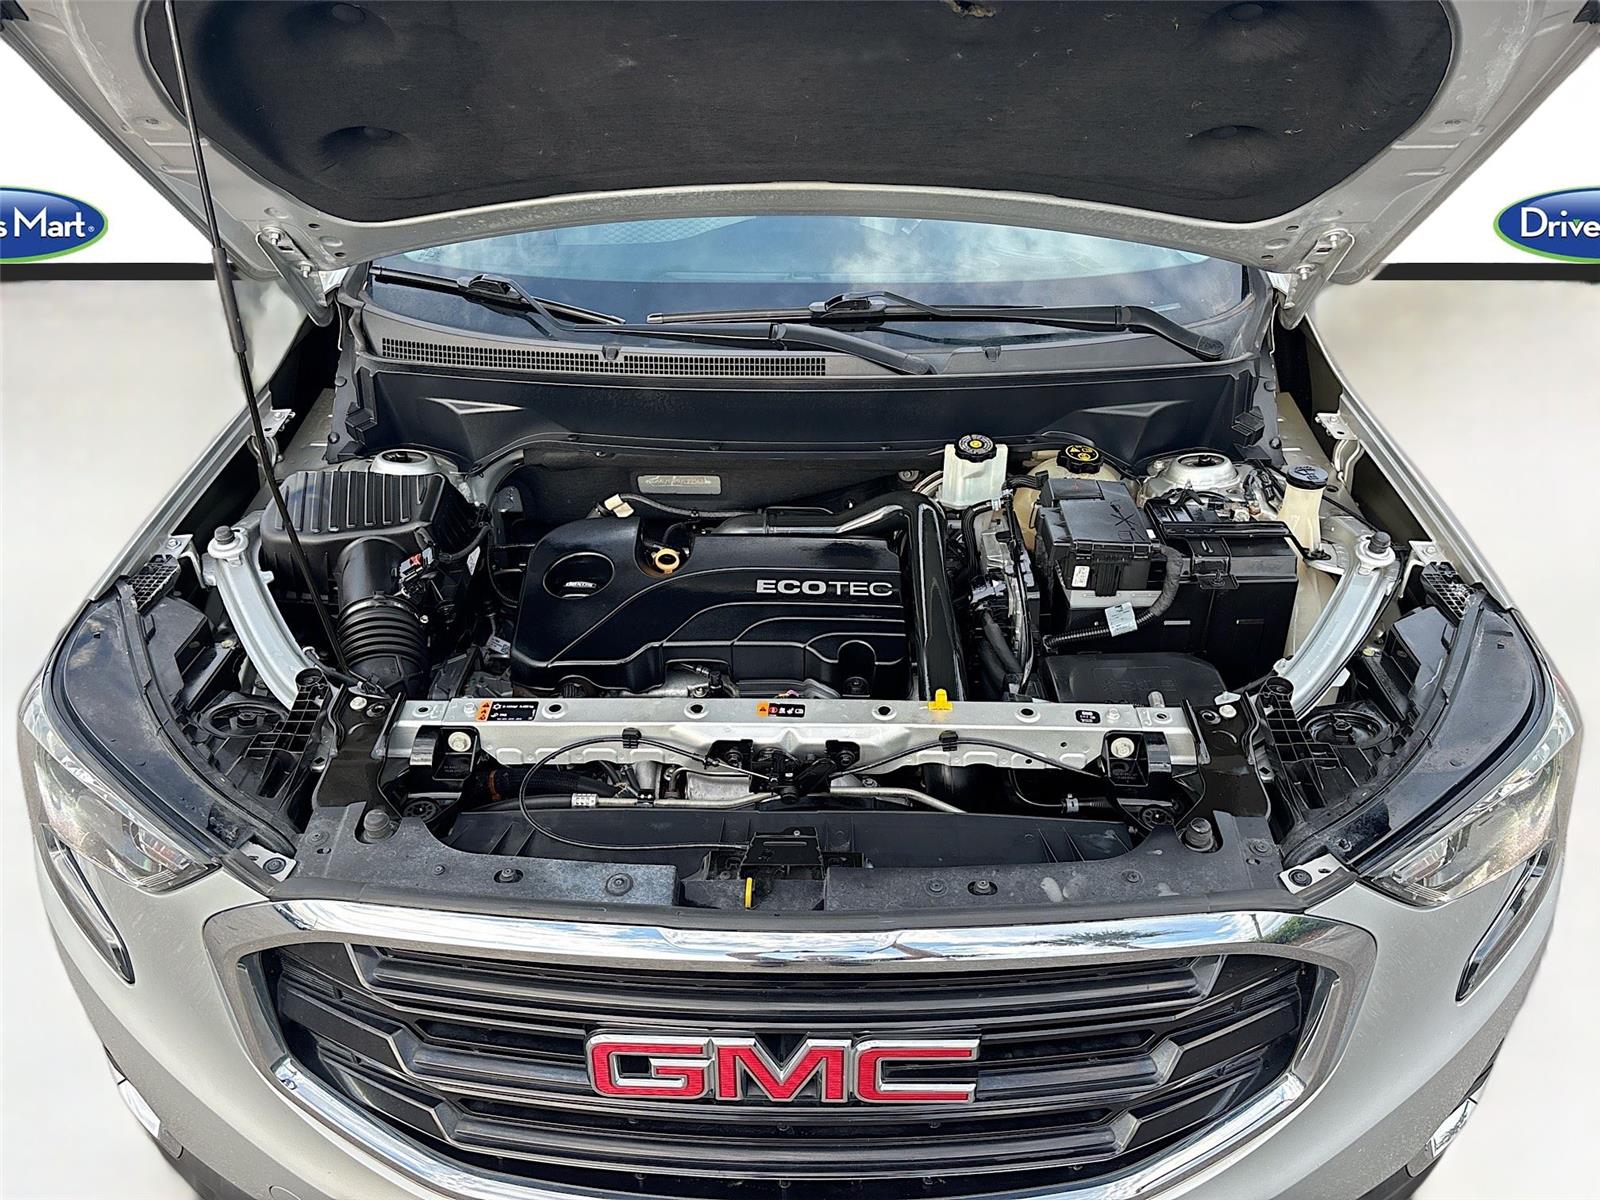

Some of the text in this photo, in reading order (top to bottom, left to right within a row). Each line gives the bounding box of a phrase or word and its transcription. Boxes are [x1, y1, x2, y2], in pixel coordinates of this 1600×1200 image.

[13, 206, 86, 238] Mart
[1520, 206, 1600, 238] Drive
[756, 579, 893, 597] ECOTEC
[584, 1031, 980, 1103] GMC
